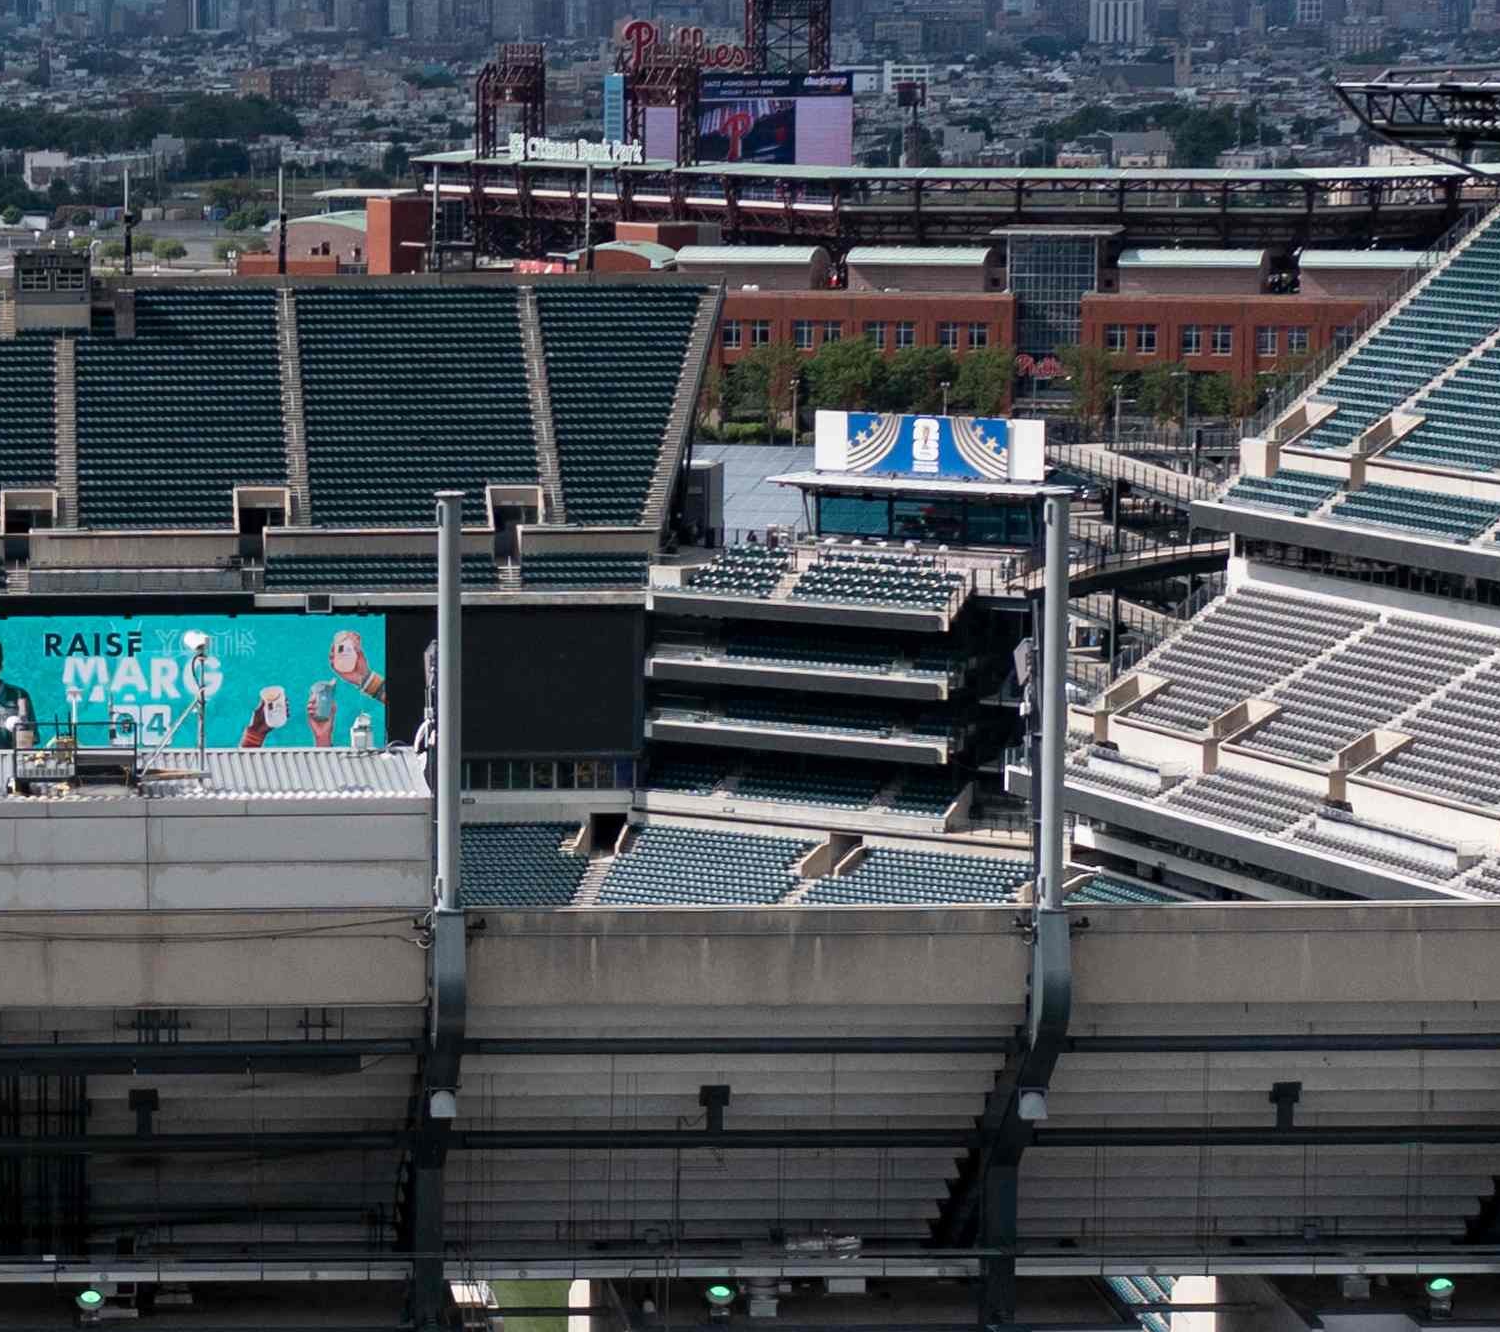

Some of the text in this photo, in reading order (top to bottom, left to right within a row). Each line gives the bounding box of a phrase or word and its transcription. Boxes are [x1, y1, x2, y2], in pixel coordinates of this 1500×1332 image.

[526, 136, 643, 164] Citizens Bank Park
[44, 631, 142, 657] RAISE
